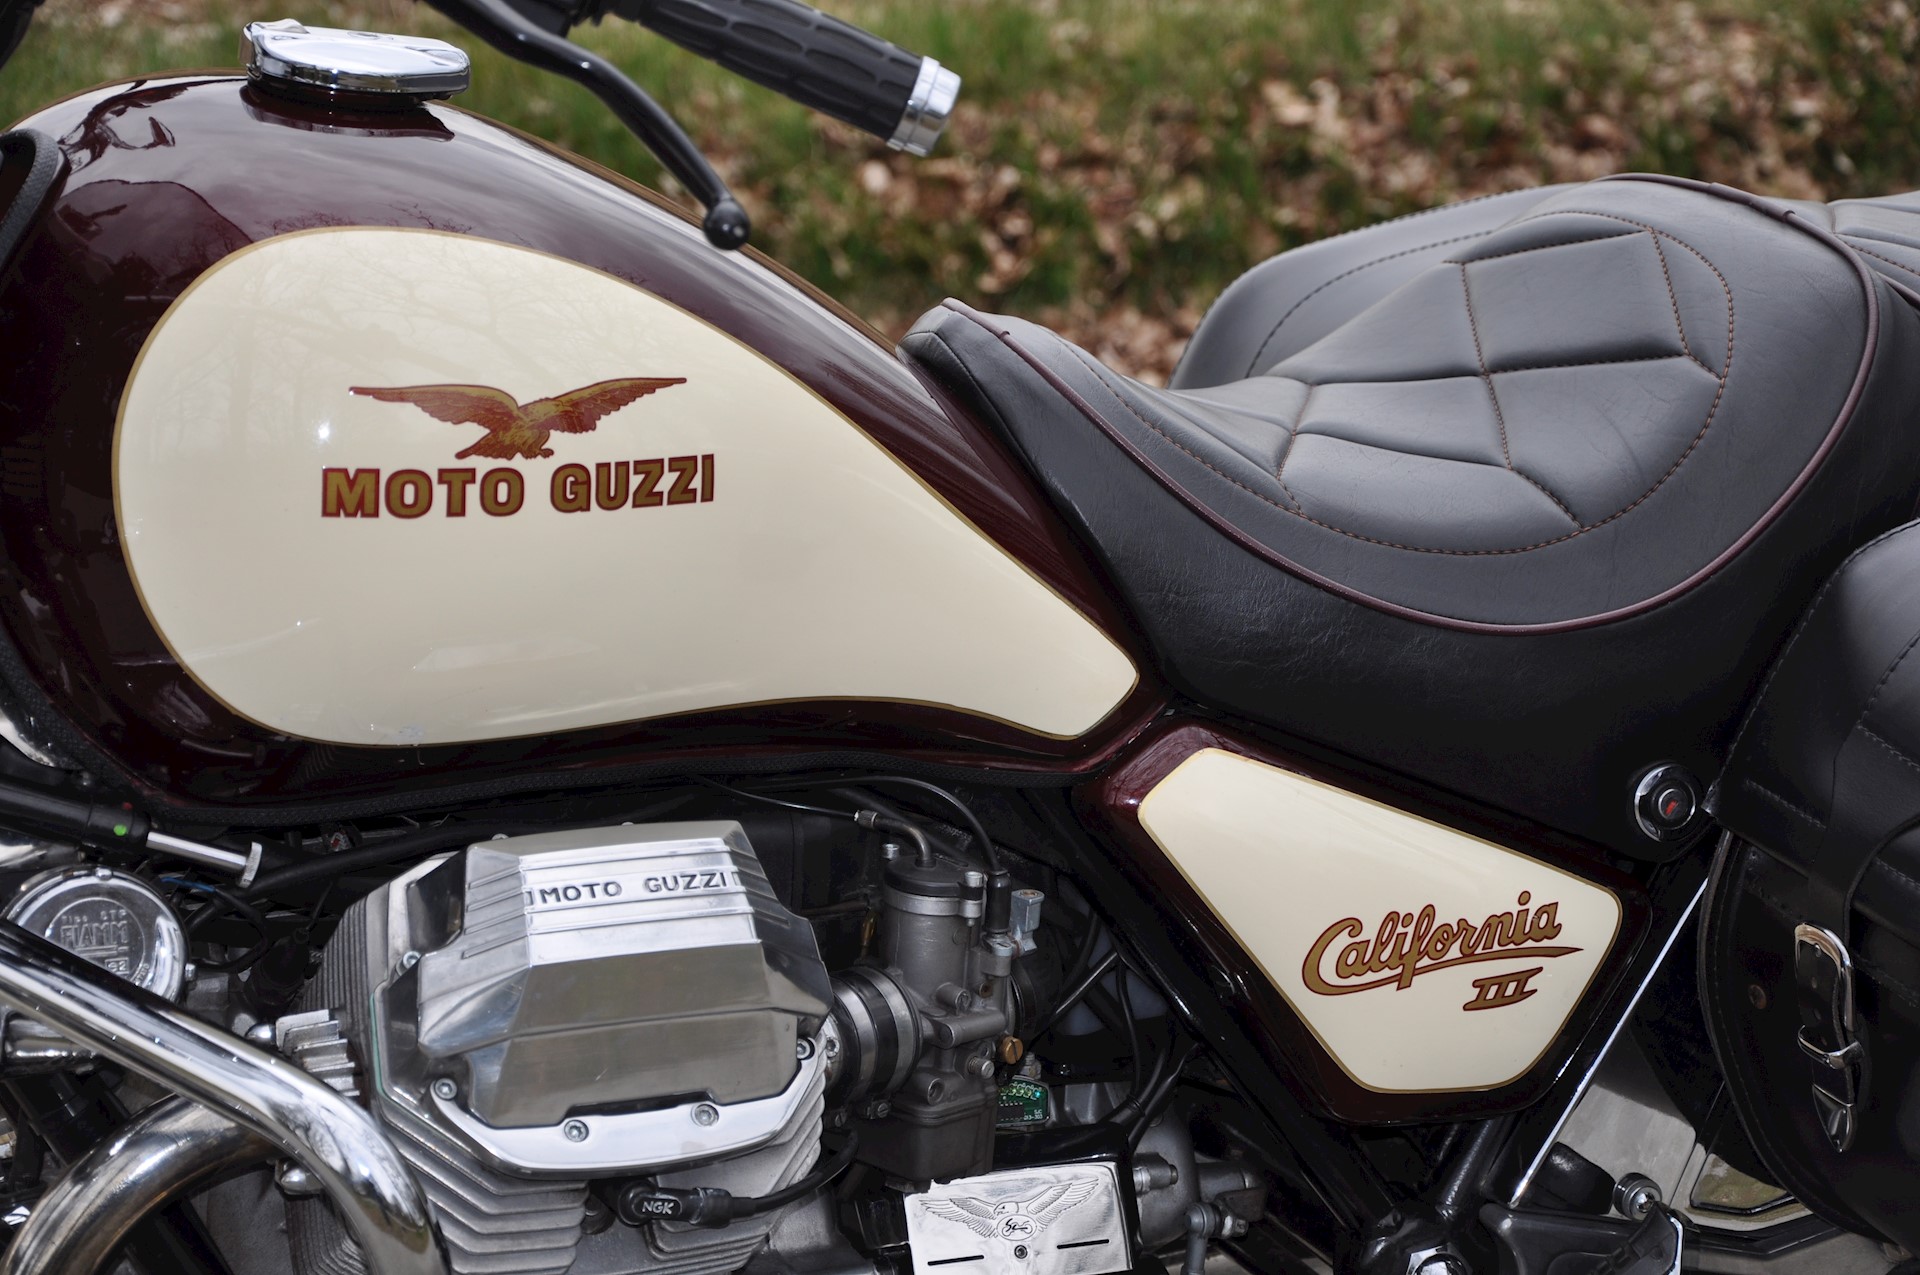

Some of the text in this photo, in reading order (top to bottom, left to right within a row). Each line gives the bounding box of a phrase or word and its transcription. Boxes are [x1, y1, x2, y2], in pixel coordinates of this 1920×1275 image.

[321, 453, 715, 519] MOTO GUZZI
[539, 871, 727, 905] MOTO GUZZI
[60, 920, 129, 948] FIAMM
[1301, 890, 1584, 996] California
[1462, 966, 1544, 1012] III
[641, 1201, 675, 1215] NGK
